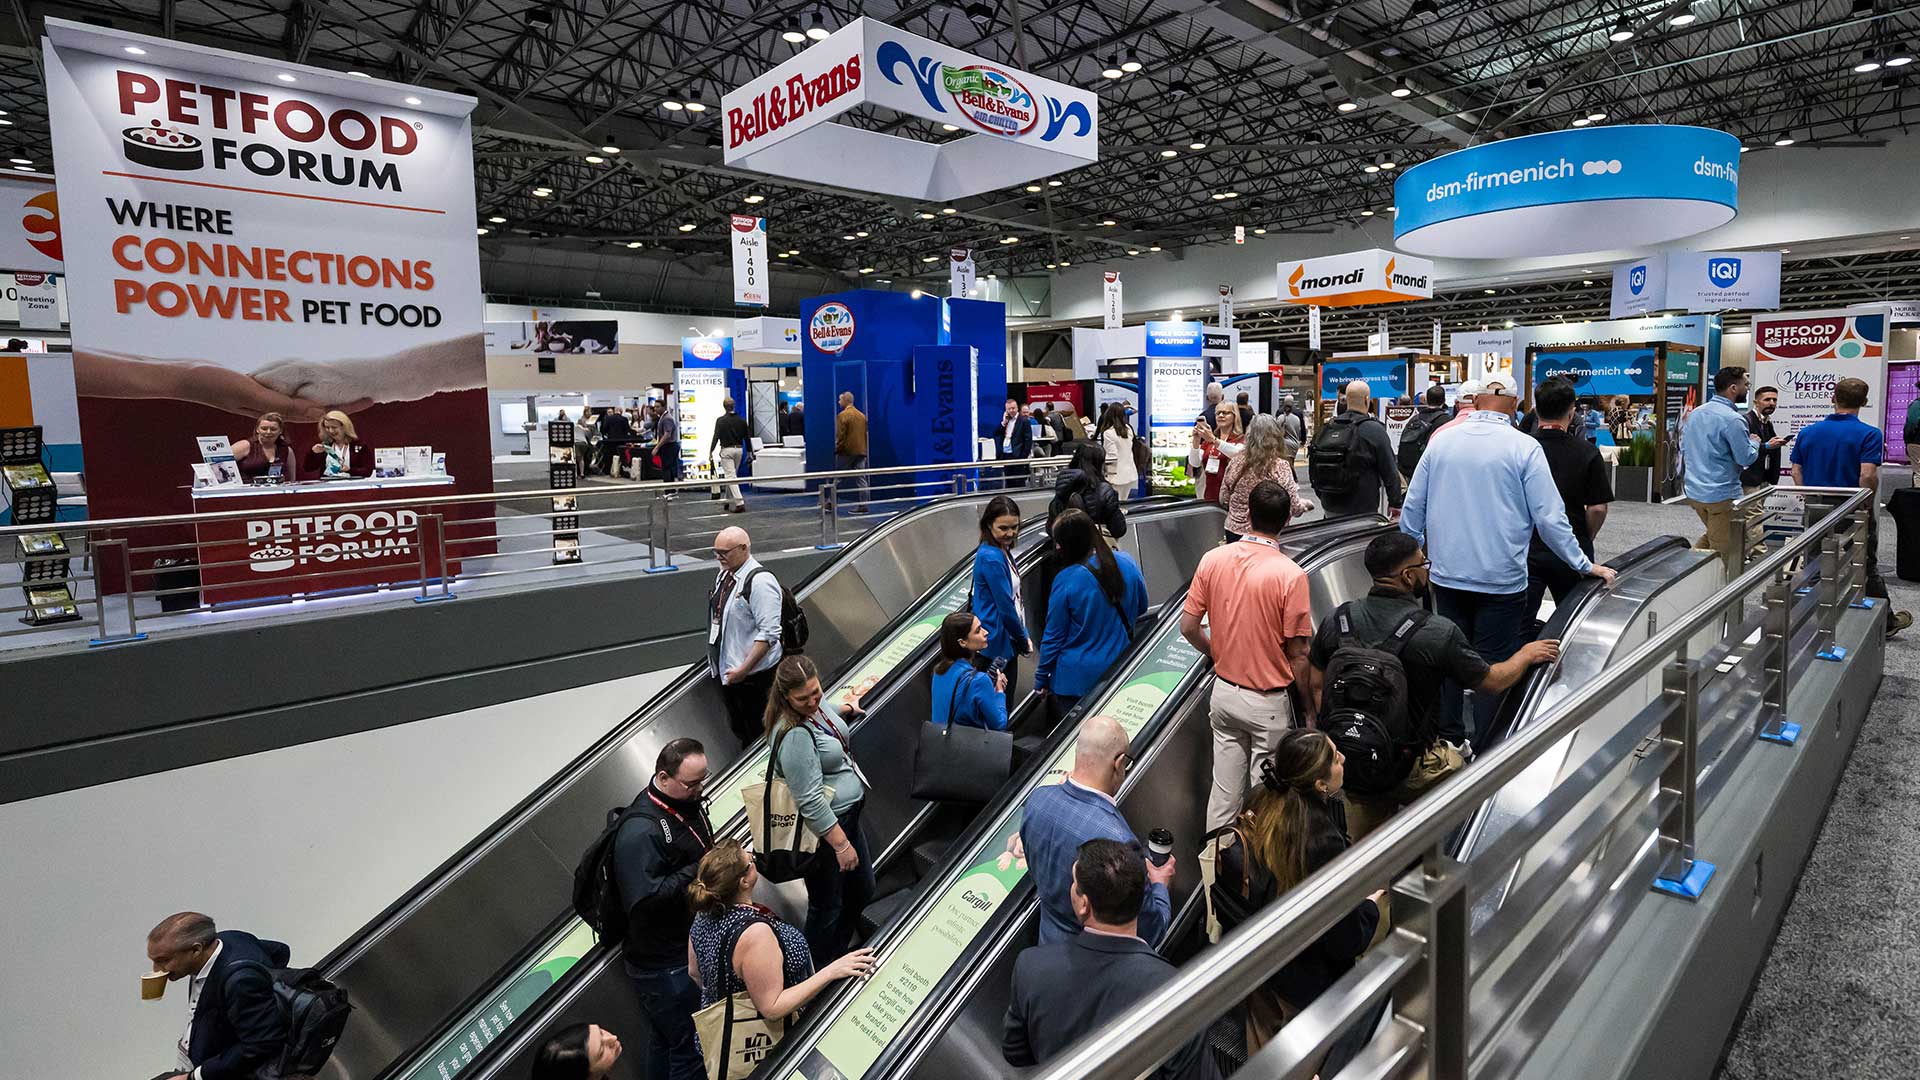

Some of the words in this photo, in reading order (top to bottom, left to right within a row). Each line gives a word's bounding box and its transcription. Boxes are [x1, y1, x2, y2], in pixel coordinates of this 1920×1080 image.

[945, 73, 979, 89] Organic
[728, 54, 860, 149] Bell&Evans
[962, 89, 1030, 121] Bell&Evans
[213, 140, 402, 192] FORUM
[1426, 158, 1574, 202] dsm-firmenich
[106, 197, 233, 235] WHERE
[740, 237, 759, 246] Aisle
[112, 234, 435, 291] CONNECTIONS
[747, 248, 755, 286] 1400
[1712, 263, 1737, 279] iQi
[1301, 268, 1364, 290] mondi
[1393, 273, 1427, 289] mondi
[1631, 270, 1645, 287] iQi
[20, 296, 55, 304] Meeting
[114, 279, 293, 322] POWER
[302, 300, 351, 325] PET
[360, 302, 442, 328] FOOD
[812, 325, 852, 339] Bell&Evans
[1639, 323, 1684, 331] dsm-firmenich
[1765, 325, 1836, 338] PETFOOD
[1208, 338, 1228, 346] ZINPRO
[1782, 336, 1830, 346] FORUM
[1154, 368, 1202, 376] PRODUCTS
[1545, 366, 1621, 378] dsm-firmenich
[1783, 370, 1836, 386] Women
[1795, 382, 1836, 391] PETFO
[247, 510, 420, 546] PETFOOD
[300, 537, 411, 565] FORUM
[961, 890, 992, 912] Cargill
[898, 975, 917, 993] #2119
[901, 962, 915, 975] Visit
[912, 971, 930, 987] booth
[877, 989, 897, 1007] Cargill
[894, 1004, 906, 1015] can
[885, 980, 893, 989] to
[891, 986, 903, 997] see
[900, 993, 915, 1006] how
[499, 1000, 508, 1011] See
[505, 1008, 514, 1020] how
[871, 1000, 886, 1013] take
[882, 1011, 897, 1024] your
[850, 1015, 861, 1026] the
[858, 1023, 872, 1036] next
[864, 1010, 882, 1027] brand
[879, 1023, 888, 1032] to
[459, 1042, 468, 1054] can
[465, 1051, 473, 1063] gro
[449, 1057, 460, 1070] your
